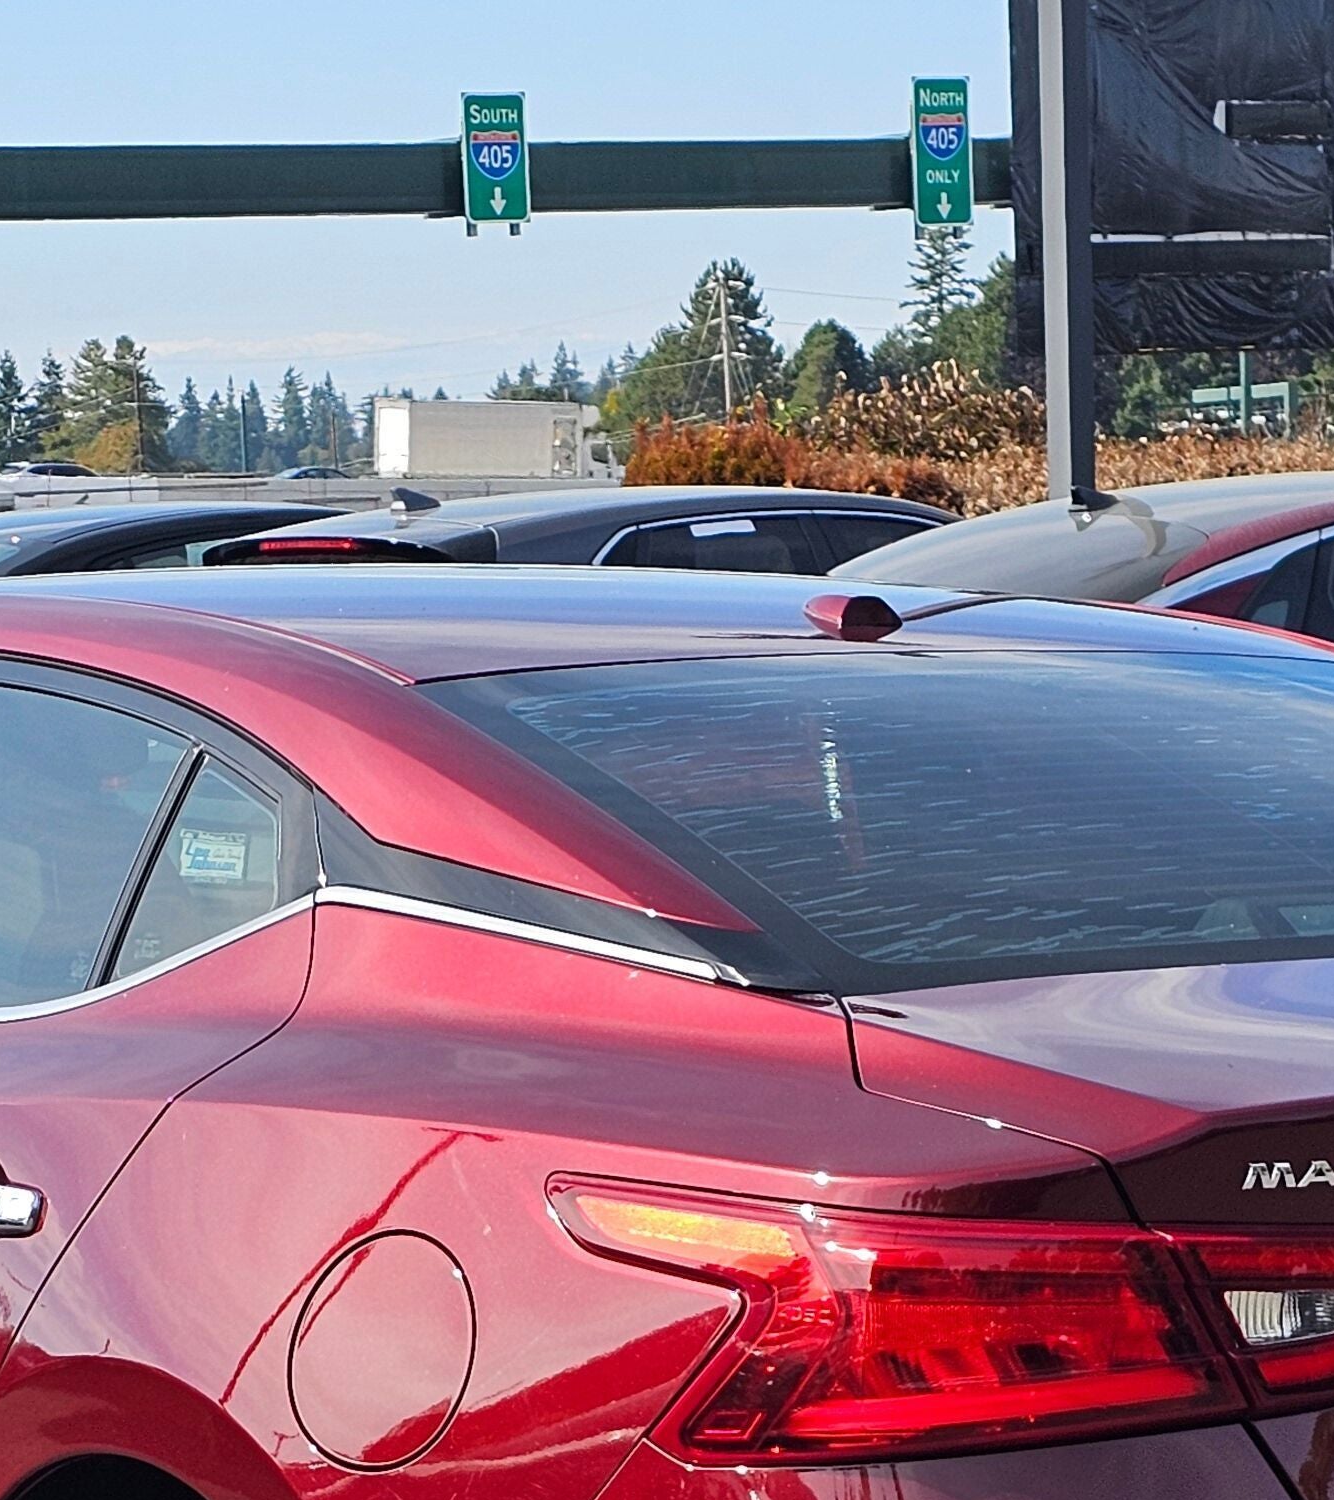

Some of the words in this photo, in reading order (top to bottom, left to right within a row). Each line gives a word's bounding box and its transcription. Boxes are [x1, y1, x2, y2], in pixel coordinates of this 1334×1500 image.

[919, 88, 964, 107] NORTH
[469, 104, 518, 124] SOUTH
[927, 127, 959, 150] 405
[478, 145, 513, 168] 405
[926, 169, 960, 184] ONLY
